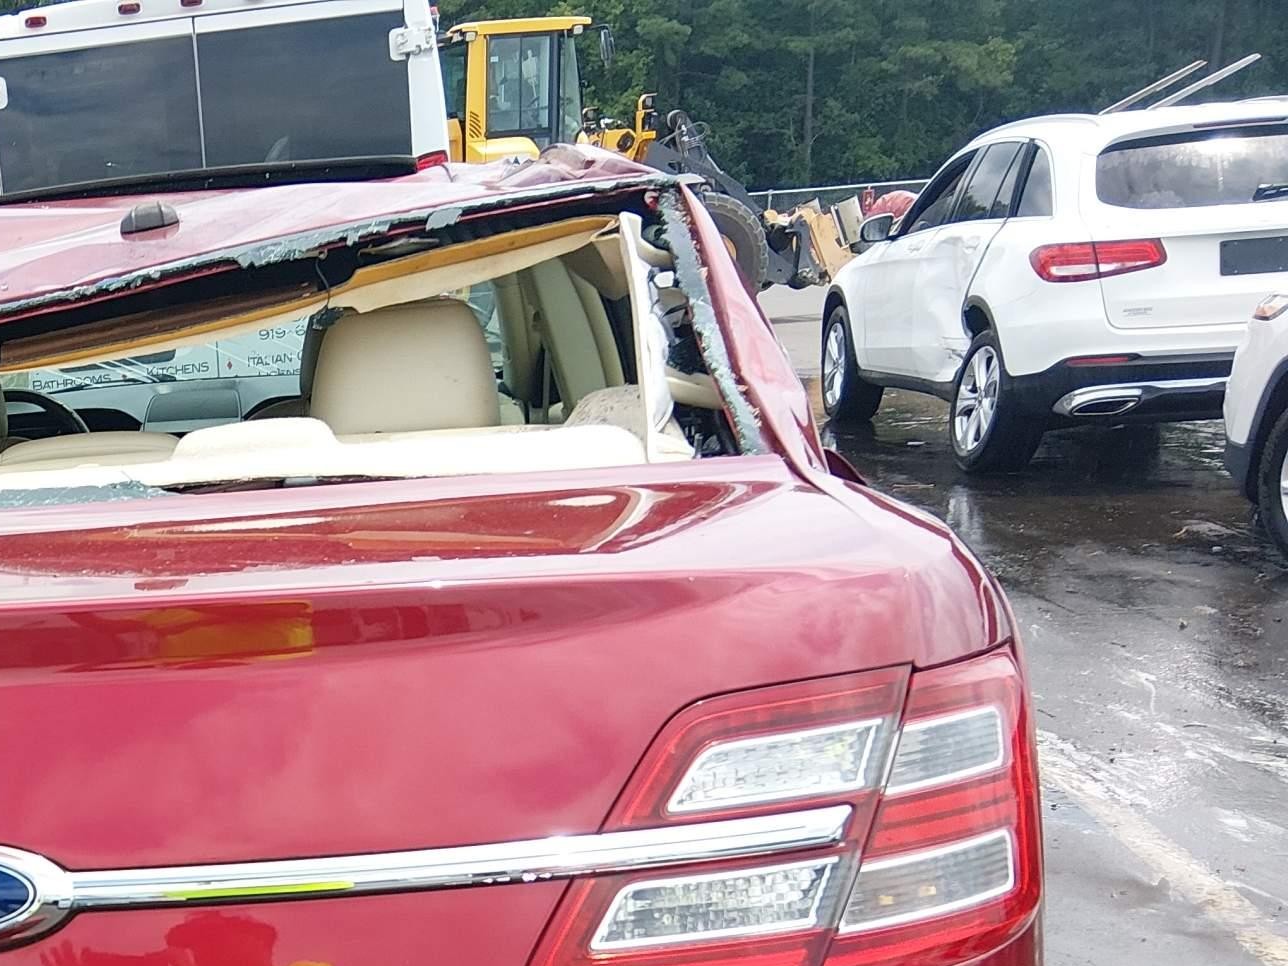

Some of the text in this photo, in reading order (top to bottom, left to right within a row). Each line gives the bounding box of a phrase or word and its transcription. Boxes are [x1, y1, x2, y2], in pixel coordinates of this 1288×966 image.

[247, 352, 293, 368] ITALIAN
[146, 361, 210, 377] KITCHENS
[32, 373, 112, 391] BATHROOMS
